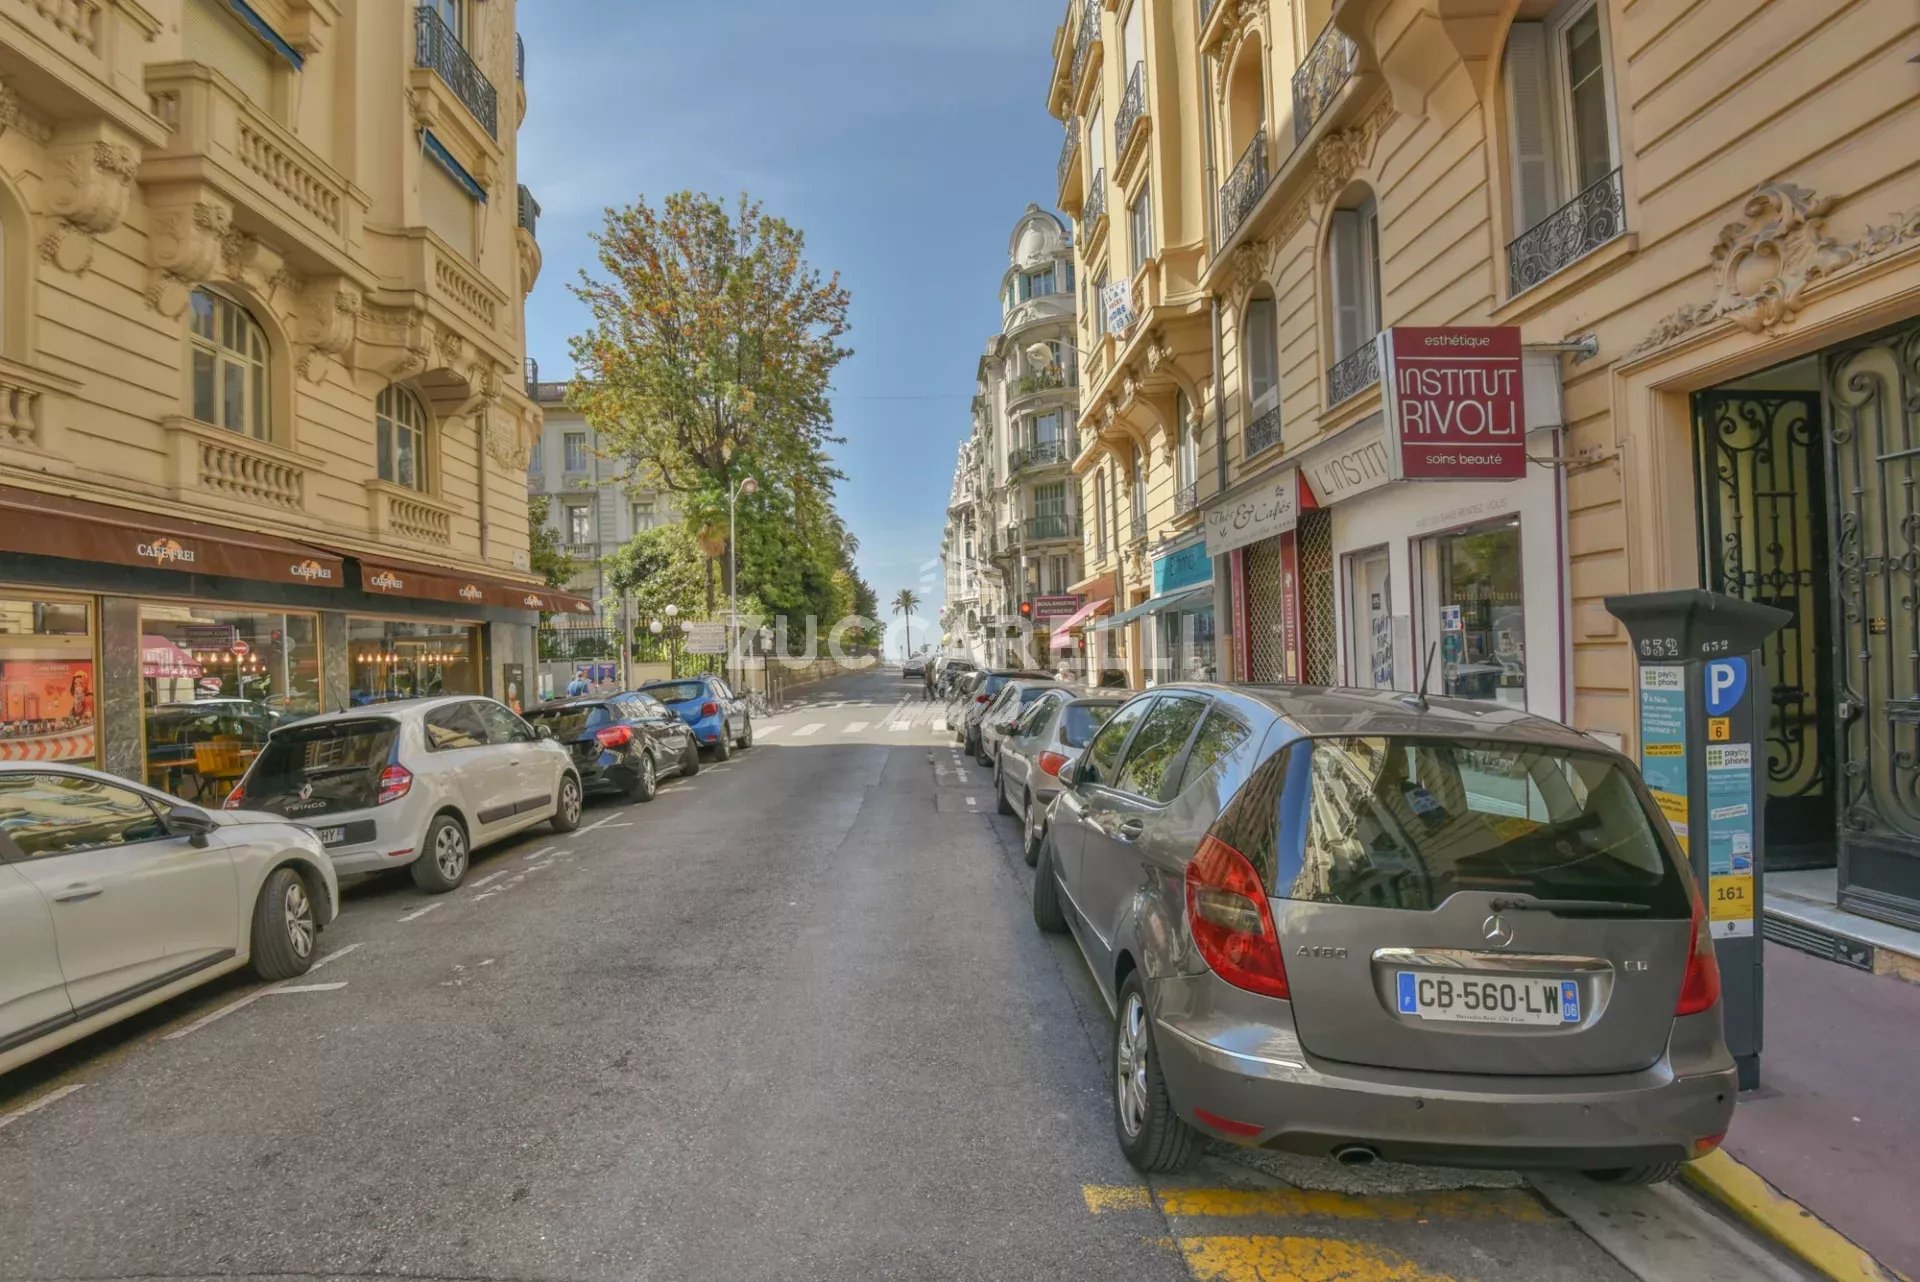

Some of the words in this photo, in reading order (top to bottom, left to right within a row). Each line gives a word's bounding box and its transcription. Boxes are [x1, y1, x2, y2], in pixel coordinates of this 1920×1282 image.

[1424, 335, 1490, 348] esthétique
[1400, 368, 1517, 396] INSTITUT
[1402, 400, 1516, 435] RIVOLI
[1426, 453, 1456, 464] soins
[1459, 452, 1503, 465] beauté
[1658, 679, 1679, 687] phone
[1711, 664, 1735, 705] P
[1715, 727, 1723, 738] 6
[1725, 749, 1748, 758] payby
[1725, 757, 1749, 766] phone
[284, 801, 326, 812] TWINGO
[1717, 886, 1745, 901] 161
[1405, 997, 1411, 1005] F
[1563, 1003, 1577, 1017] 06
